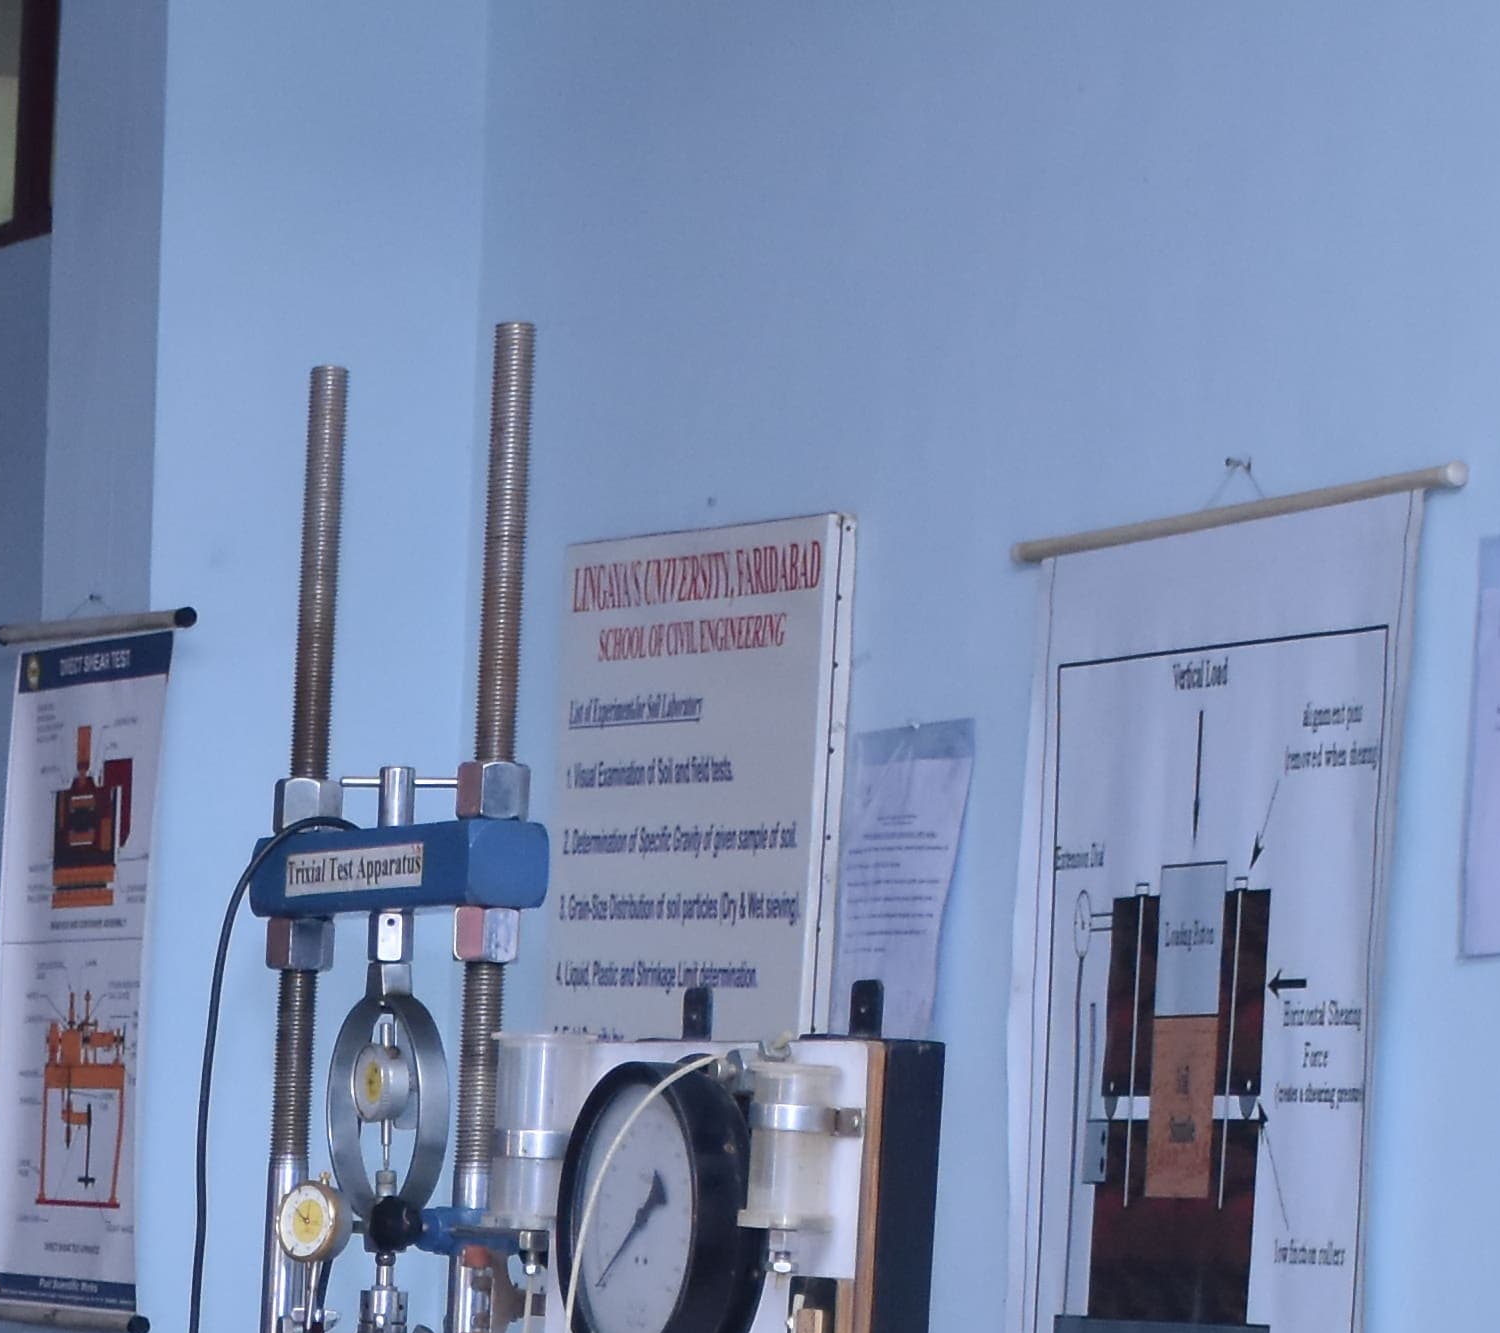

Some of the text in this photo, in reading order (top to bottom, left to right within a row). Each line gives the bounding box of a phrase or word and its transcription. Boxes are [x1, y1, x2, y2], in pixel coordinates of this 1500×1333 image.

[736, 540, 821, 597] FARIDABAD
[598, 612, 788, 662] SCHOOL OF CIVIL ENGINEERING
[1205, 657, 1229, 687] Load
[574, 763, 597, 789] Visual
[598, 761, 646, 788] Examination
[657, 757, 674, 785] Soil
[675, 758, 690, 785] and
[691, 756, 710, 784] field
[288, 854, 421, 885] Trixial Test Apparatus
